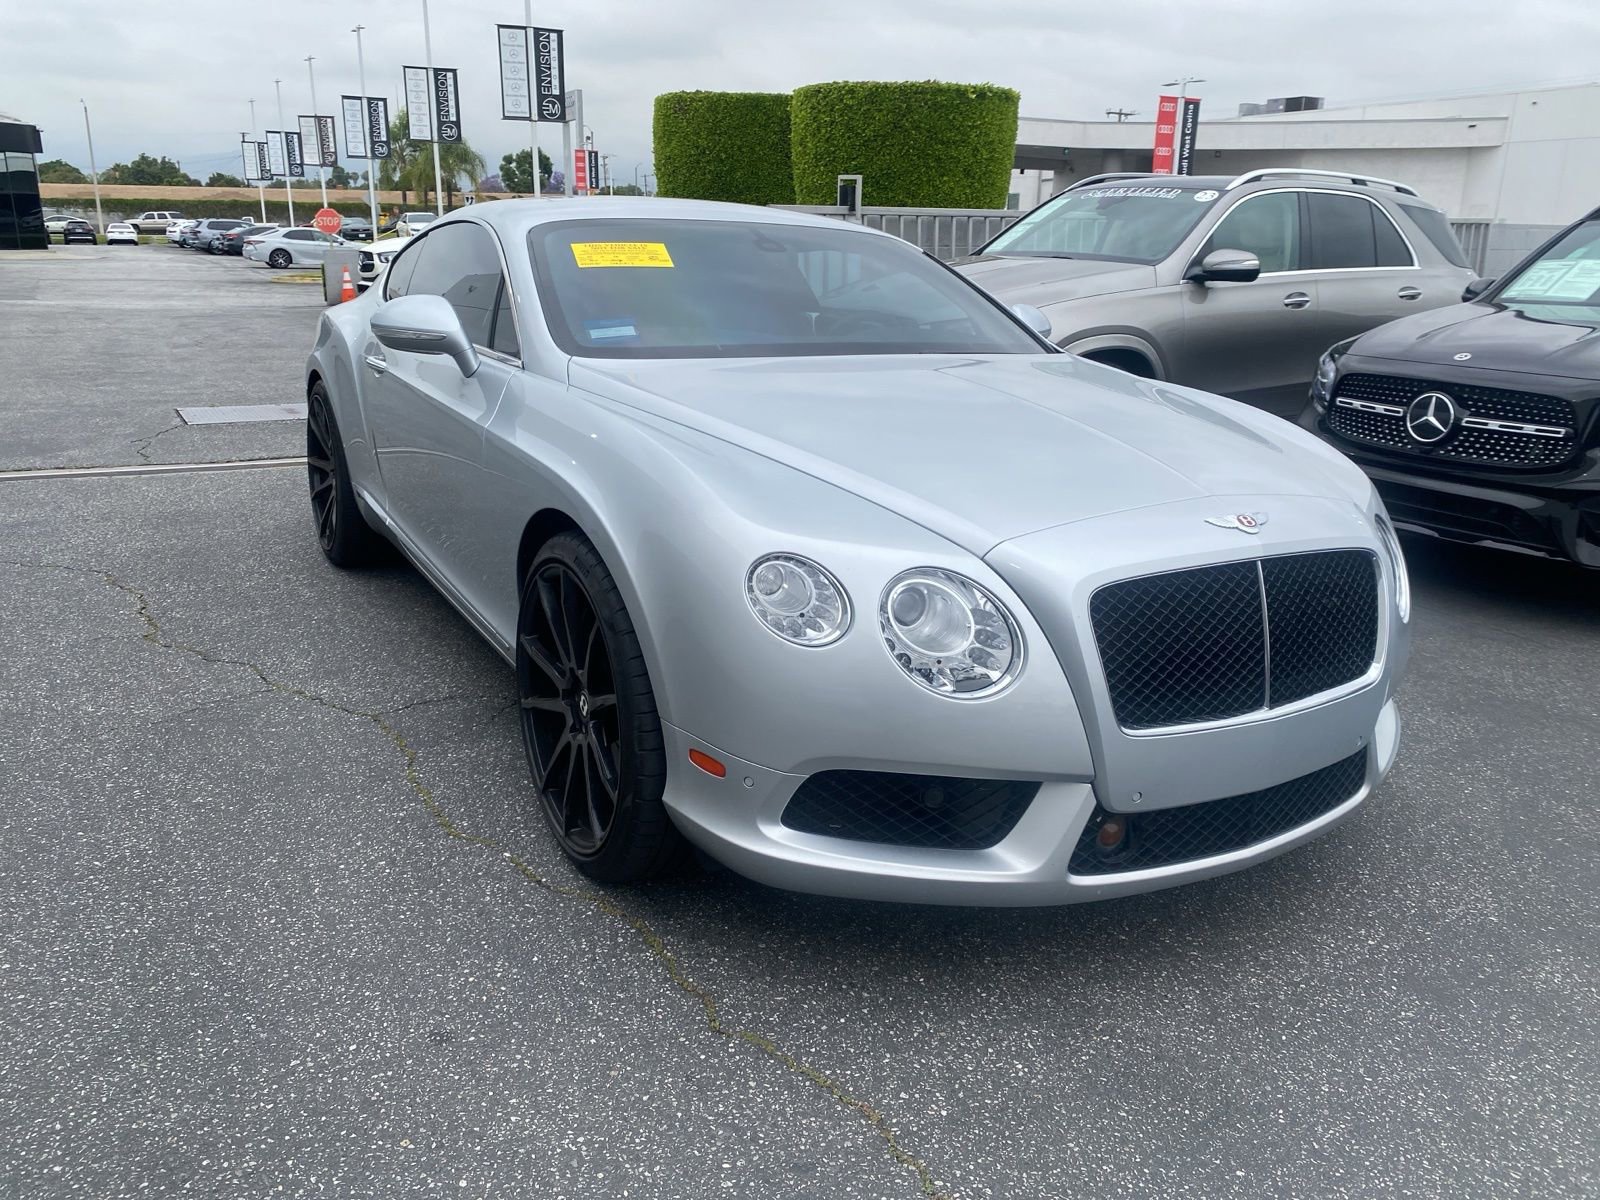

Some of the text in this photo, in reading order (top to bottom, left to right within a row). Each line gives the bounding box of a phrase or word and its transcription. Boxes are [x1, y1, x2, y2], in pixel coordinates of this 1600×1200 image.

[539, 31, 552, 95] ENVISION
[437, 71, 450, 121] ENVISION
[370, 100, 381, 141] ENVISION
[1181, 104, 1195, 176] udi West Covina
[1097, 187, 1182, 197] CERTIFIED
[318, 217, 339, 226] STOP
